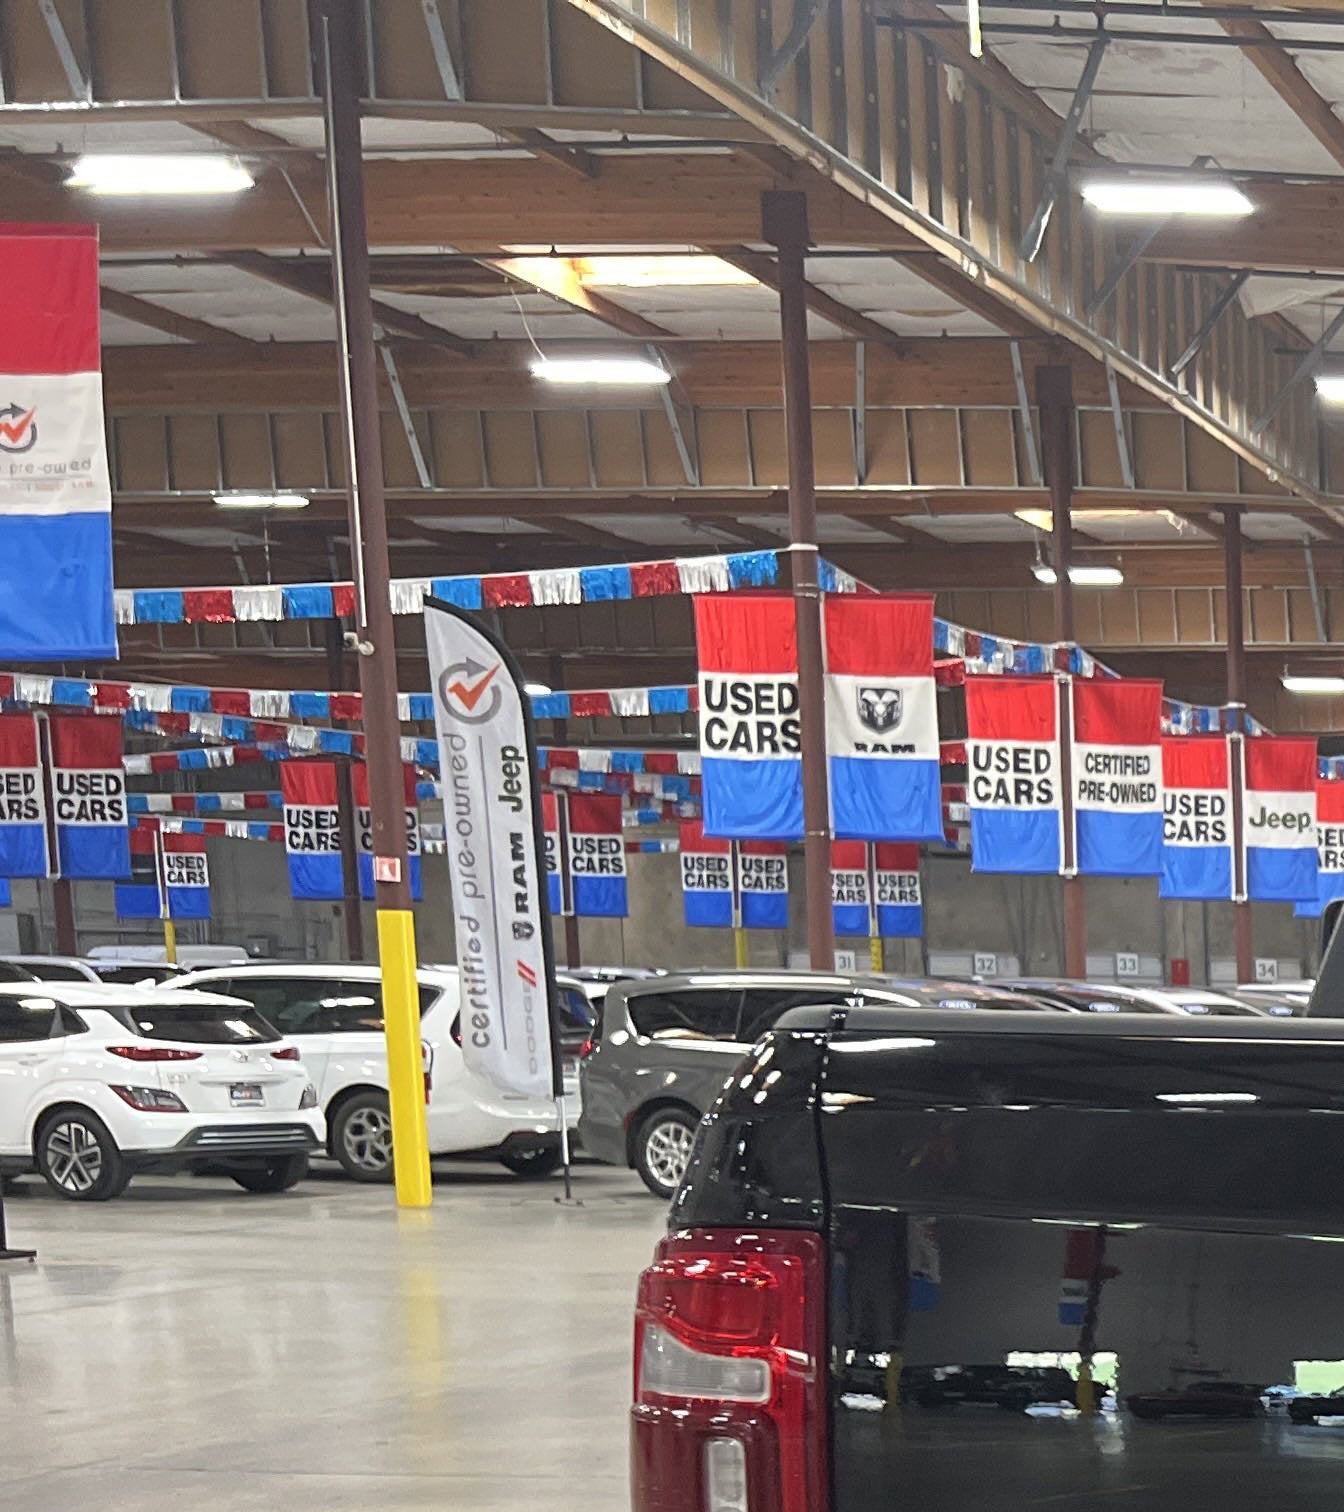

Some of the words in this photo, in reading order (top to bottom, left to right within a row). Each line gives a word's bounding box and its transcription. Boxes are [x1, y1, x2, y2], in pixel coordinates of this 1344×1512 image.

[704, 679, 799, 716] USED
[704, 717, 800, 754] CARS
[854, 742, 916, 754] RAM
[972, 745, 1051, 774] USED
[1085, 752, 1150, 775] CERTIFIED
[0, 773, 35, 795] ED
[56, 773, 122, 796] USED
[498, 745, 526, 813] Jeep
[973, 775, 1054, 805] CARS
[1078, 780, 1156, 804] PRE-OWNED
[0, 799, 40, 820] RS
[57, 799, 124, 822] CARS
[1163, 793, 1225, 816] USED
[286, 809, 339, 829] USED
[359, 809, 416, 830] UD
[442, 733, 486, 899] pre-owned
[1250, 806, 1311, 833] Jeep
[1163, 819, 1226, 842] CARS
[288, 831, 341, 851] CARS
[360, 832, 417, 851] CS
[572, 837, 621, 855] USED
[166, 855, 205, 869] USED
[572, 856, 624, 874] CARS
[684, 856, 728, 872] USED
[741, 857, 785, 873] USED
[166, 870, 205, 884] CARS
[510, 832, 530, 914] RAM
[684, 873, 729, 888] CARS
[741, 874, 786, 890] CARS
[831, 873, 865, 886] SED
[877, 874, 917, 887] USED
[831, 889, 867, 903] ARS
[877, 890, 918, 903] CARS
[839, 956, 852, 969] 31
[977, 956, 995, 972] 32
[1118, 956, 1137, 973] 33
[1257, 962, 1275, 978] 34
[460, 915, 491, 1048] certified
